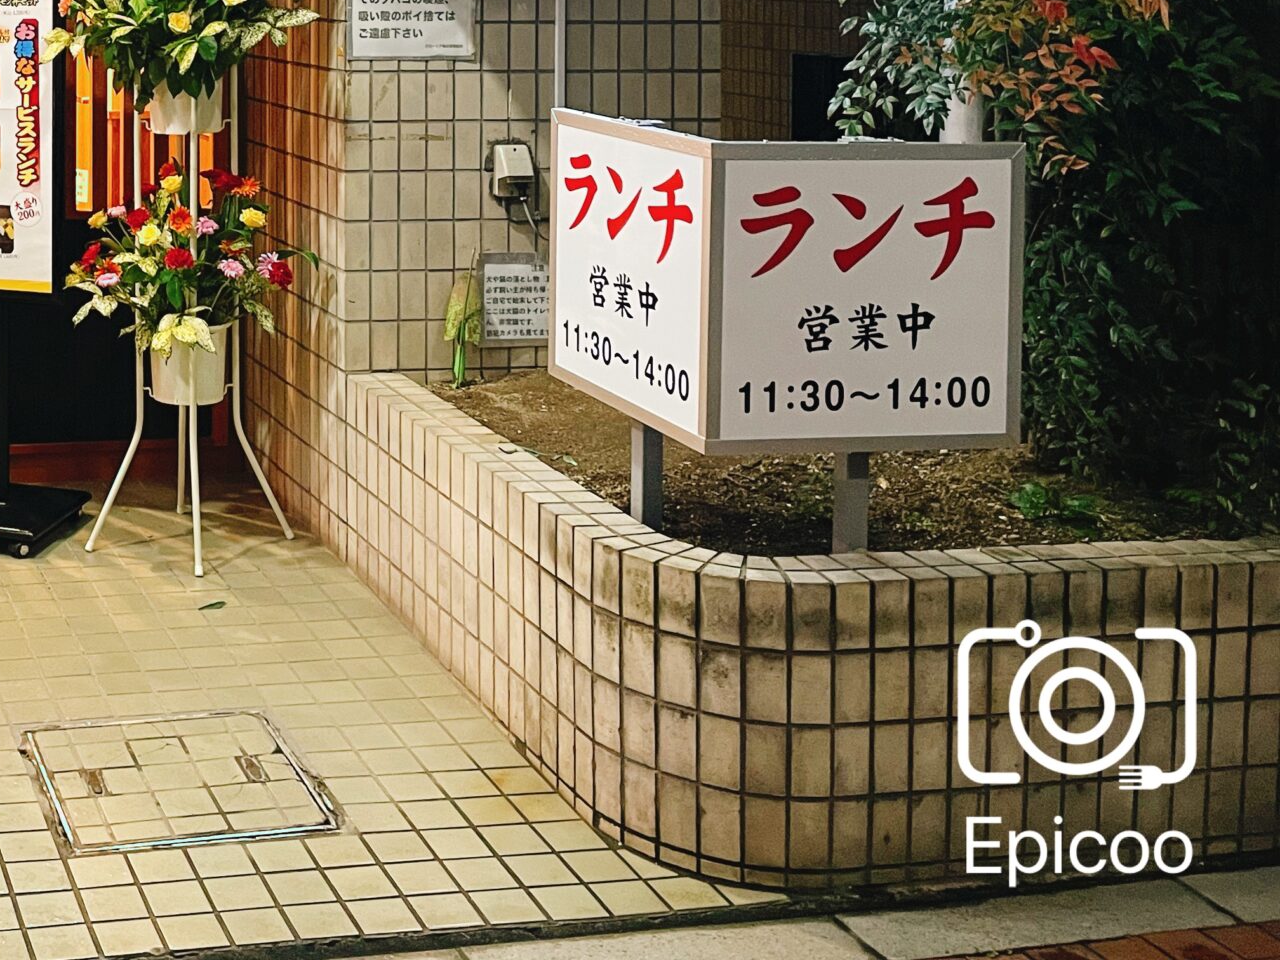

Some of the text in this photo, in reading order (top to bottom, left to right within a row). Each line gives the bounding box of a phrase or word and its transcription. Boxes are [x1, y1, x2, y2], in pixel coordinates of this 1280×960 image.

[358, 10, 456, 22] 吸い殻のポイ捨ては
[358, 27, 424, 39] ご遠慮下さい
[563, 153, 694, 264] ランチ
[740, 176, 996, 280] ランチ
[486, 286, 549, 294] 必ず飼い主が持ち帰
[589, 265, 659, 327] 営業中
[797, 303, 936, 353] 営業中
[562, 319, 691, 402] 11:30～14:00
[738, 376, 991, 414] 11:30～14:00
